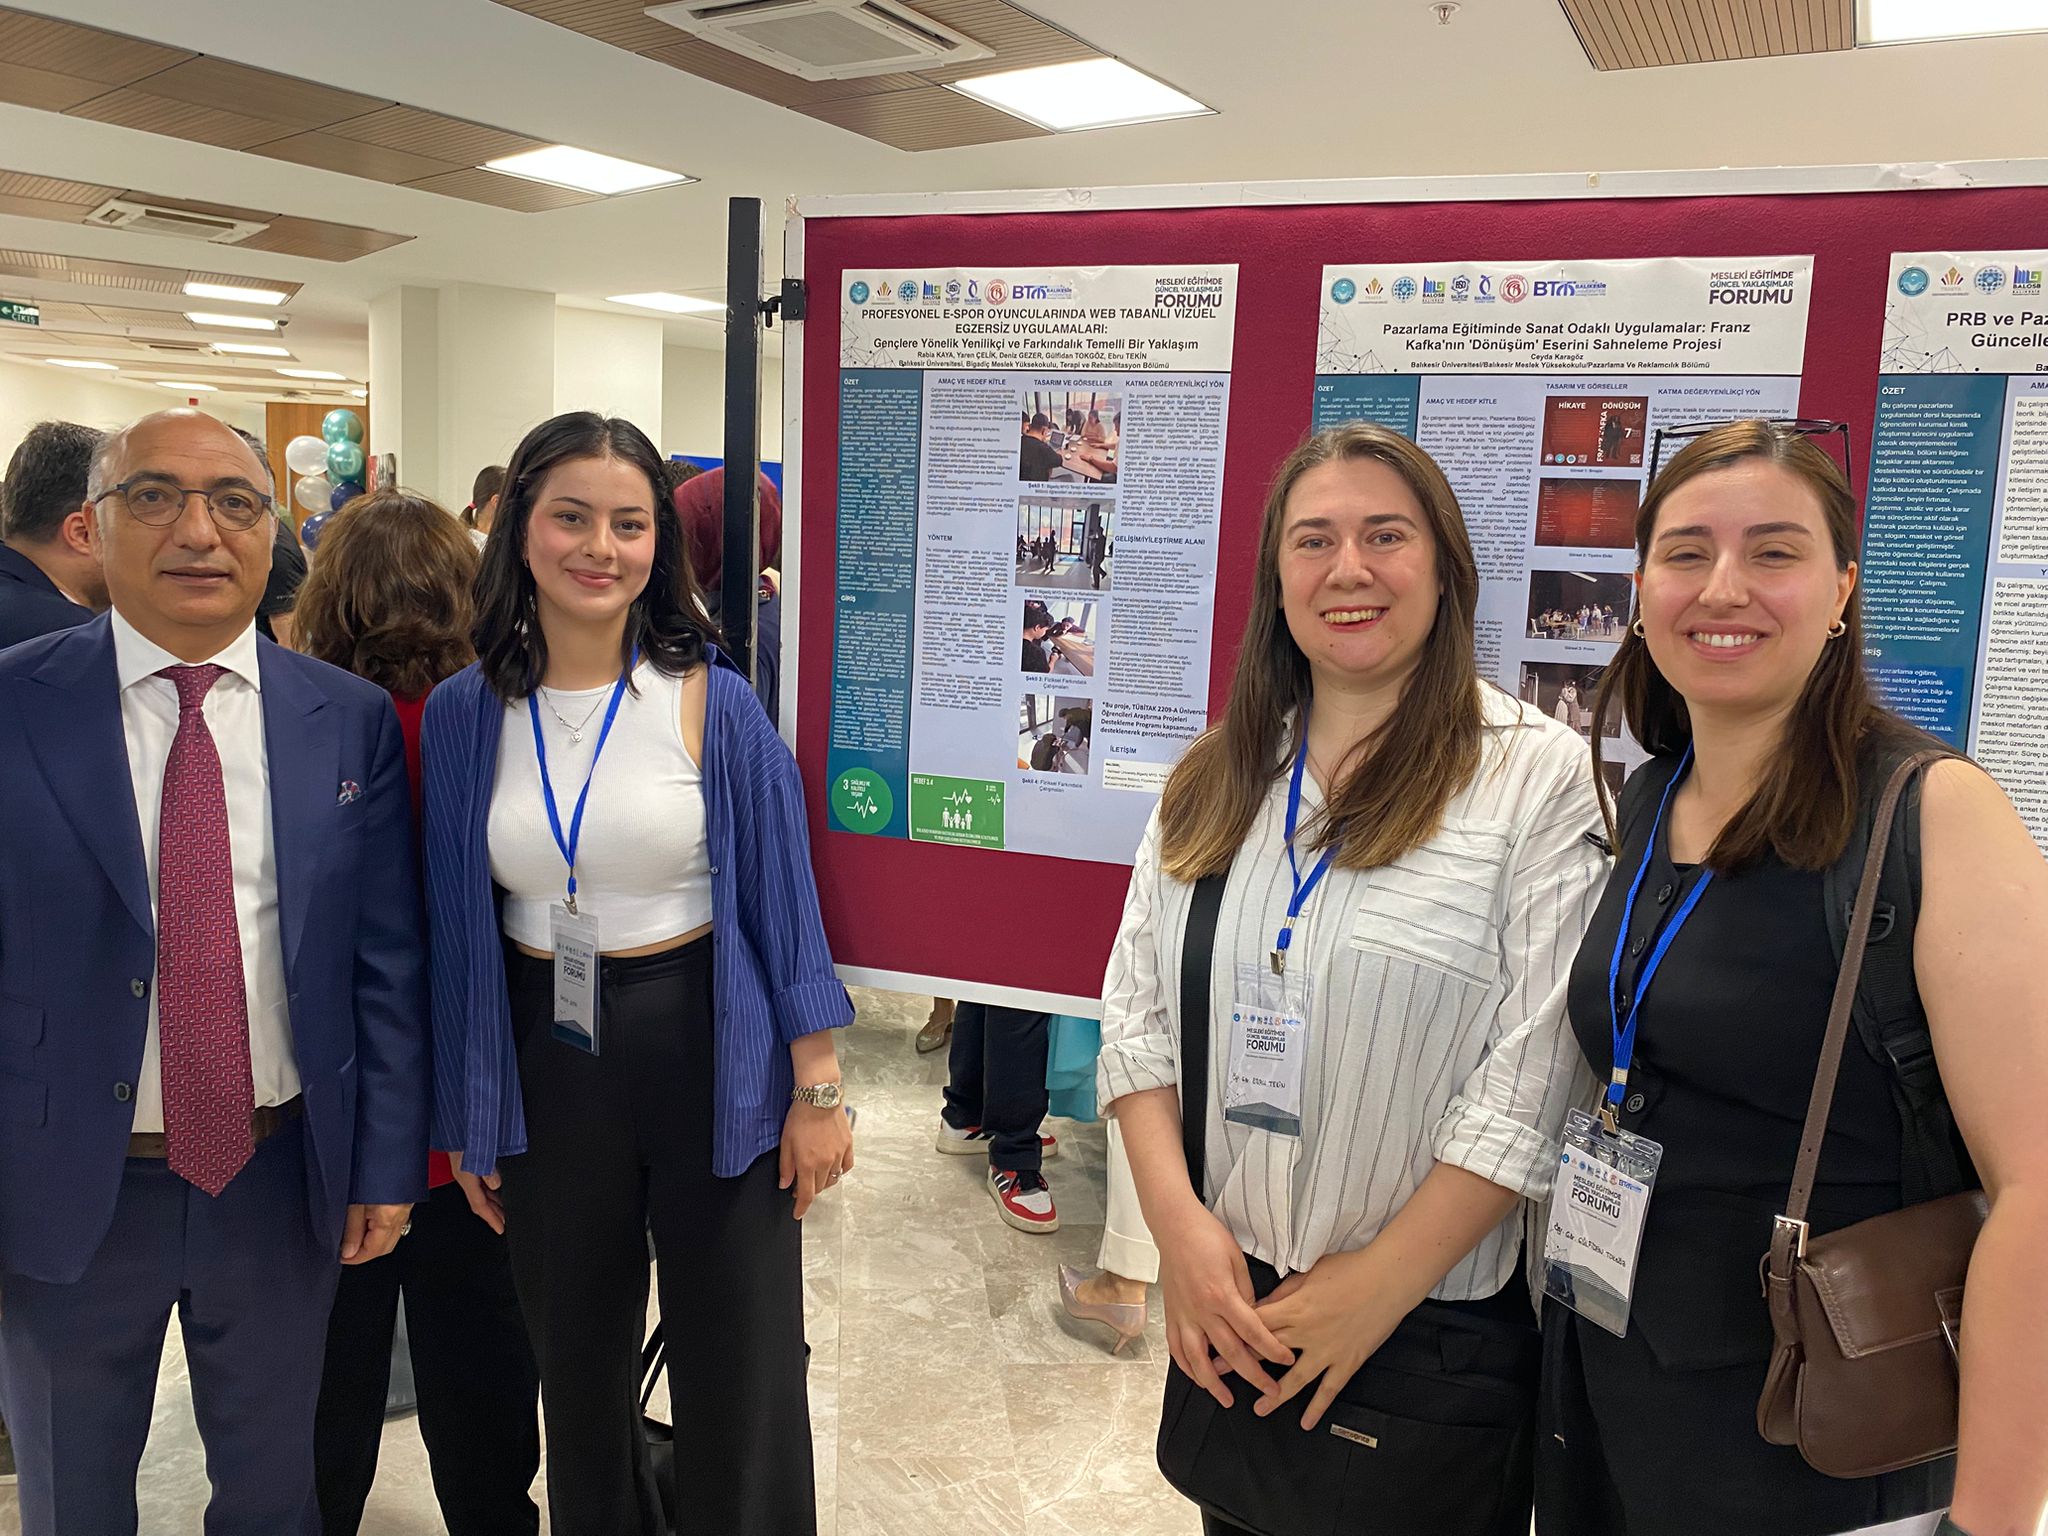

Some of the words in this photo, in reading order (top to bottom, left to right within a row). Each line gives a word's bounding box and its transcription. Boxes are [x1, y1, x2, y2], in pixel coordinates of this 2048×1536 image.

[1711, 271, 1748, 280] MESLEKİ
[1750, 270, 1793, 279] EĞİTİMDE
[1156, 277, 1186, 285] MESLEKİ
[1187, 277, 1222, 285] EĞİTİMDE
[1710, 280, 1740, 288] GÜNCEL
[1742, 280, 1793, 289] YAKLAŞIMLAR
[1155, 294, 1222, 307] FORUMU
[1709, 289, 1793, 305] FORUMU
[862, 309, 940, 319] PROFESYONEL
[943, 309, 984, 319] E-SPOR
[988, 309, 1086, 319] OYUNCULARINDA
[1089, 309, 1116, 318] WEB
[1120, 309, 1169, 318] TABANLI
[1174, 306, 1216, 318] VİZÜEL
[1946, 313, 1986, 326] PRB
[1993, 316, 2014, 325] ve
[956, 322, 1009, 334] EGZERSİZ
[1013, 324, 1108, 334] UYGULAMALARI:
[1383, 324, 1448, 335] Pazarlama
[1452, 323, 1521, 337] Eğitiminde
[1526, 323, 1563, 334] Sanat
[1568, 322, 1610, 334] Odaklı
[1615, 322, 1705, 337] Uygulamalar:
[1710, 322, 1750, 333] Franz
[874, 338, 917, 350] Gençlere
[921, 338, 958, 348] Yönelik
[961, 338, 1005, 350] Yenilikçi
[1024, 339, 1082, 349] Farkındalık
[1086, 339, 1125, 349] Temelli
[1128, 339, 1144, 349] Bir
[1149, 339, 1198, 351] Yaklaşım
[1406, 339, 1465, 350] Kafka'nın
[1469, 339, 1538, 353] 'Dönüşüm'
[1542, 339, 1588, 350] Eserini
[1593, 339, 1668, 350] Sahneleme
[1673, 338, 1722, 352] Projesi
[976, 351, 996, 360] ÇELİK,
[1019, 352, 1042, 360] GEZER,
[1076, 352, 1105, 360] TOKGÖZ,
[926, 360, 963, 368] Üniversitesi,
[966, 360, 989, 368] Bigadiç
[1016, 361, 1058, 369] Yüksekokulu,
[1060, 362, 1080, 370] Terapi
[1091, 362, 1140, 370] Rehabilitasyon
[1150, 380, 1208, 388] DEĞER/YENİLİKÇİ
[1209, 380, 1224, 388] YÖN
[1682, 388, 1743, 396] DEĞER/YENİLİKÇİ
[1882, 386, 1905, 394] ÖZET
[1426, 398, 1445, 406] AMAÇ
[1558, 401, 1586, 409] HİKAYE
[1602, 402, 1641, 410] DÖNÜŞÜM
[1624, 428, 1632, 438] 7
[1947, 487, 1981, 495] Çalışmada
[927, 533, 952, 541] YÖNTEM
[841, 595, 856, 603] GİRİŞ
[1132, 703, 1156, 711] TÜBİTAK
[1101, 710, 1132, 718] Öğrencileri
[1134, 712, 1161, 721] Araştırma
[1163, 715, 1187, 723] Projeleri
[1100, 727, 1140, 736] desteklenerek
[1136, 722, 1162, 730] Programı
[1163, 723, 1197, 732] kapsamında
[1110, 745, 1136, 754] İLETİŞİM
[843, 779, 849, 790] 3
[563, 965, 586, 981] FORUMU
[1246, 1039, 1285, 1053] FORUMU
[1571, 1188, 1620, 1219] FORUMU
